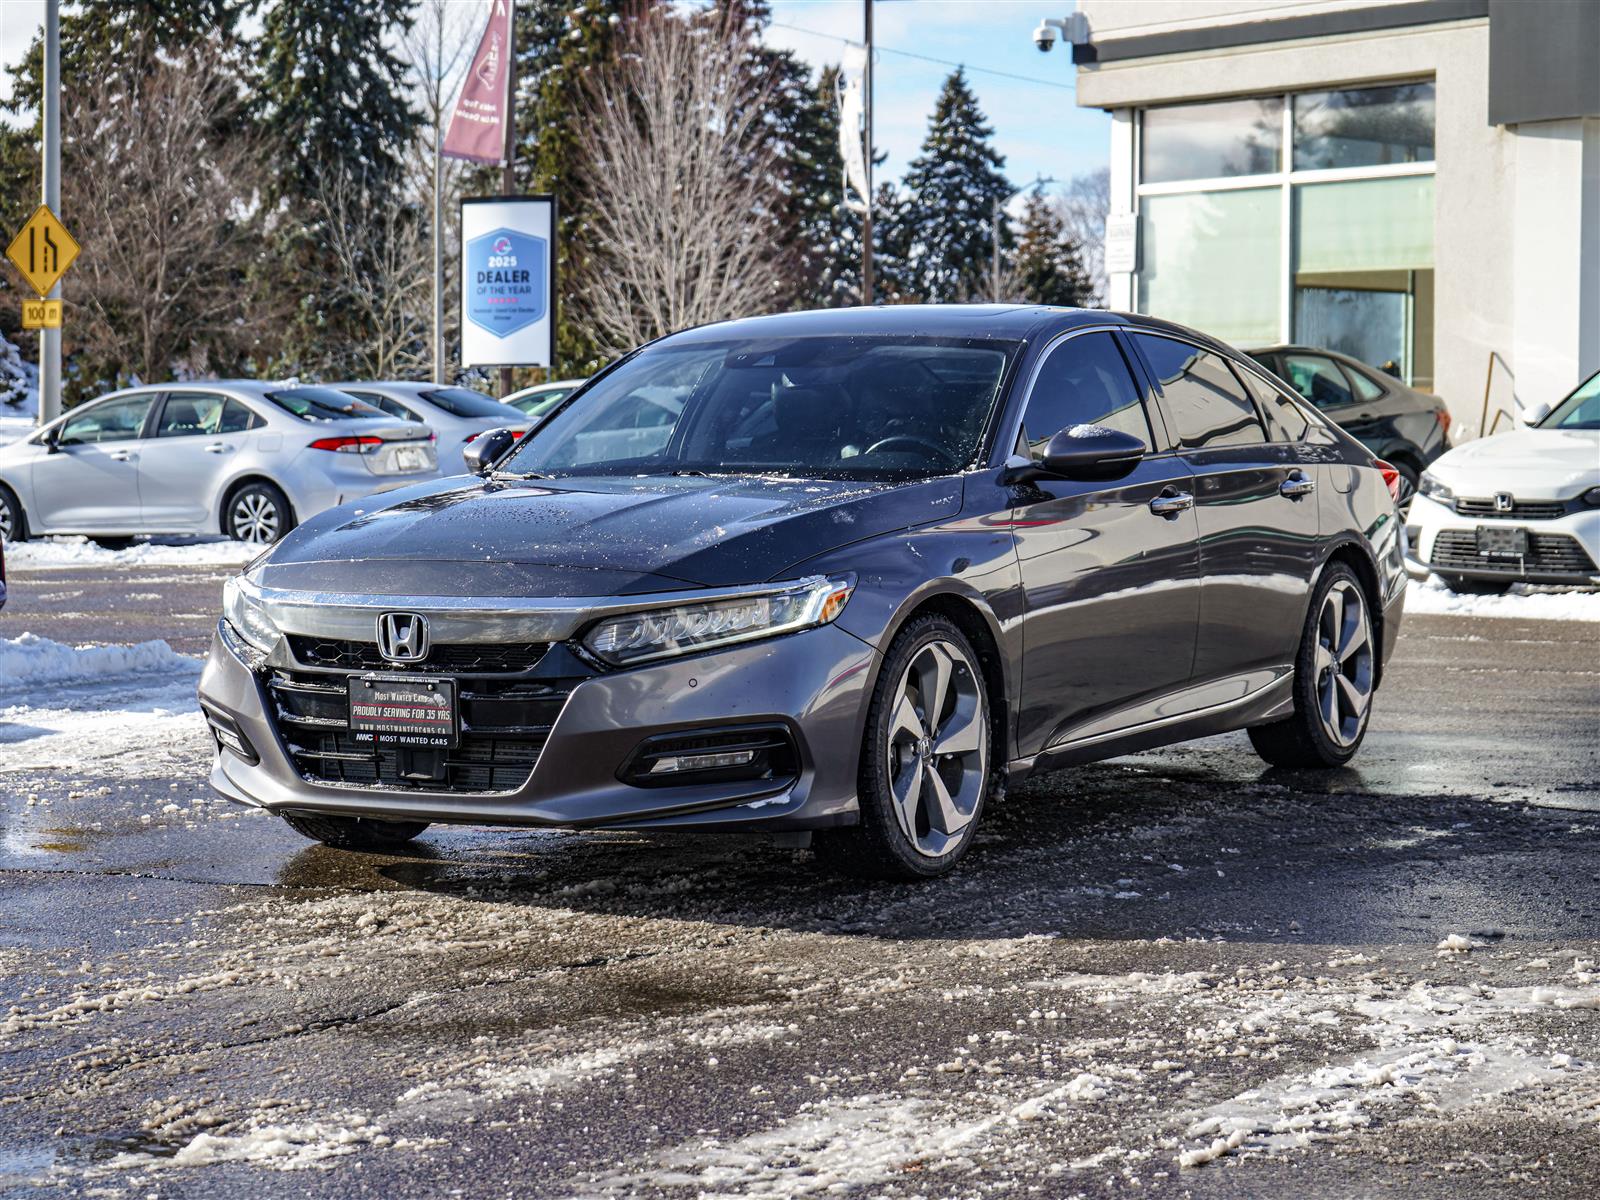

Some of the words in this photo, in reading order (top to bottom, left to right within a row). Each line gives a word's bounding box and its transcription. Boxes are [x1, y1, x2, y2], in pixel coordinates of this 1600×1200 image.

[488, 256, 517, 268] 2025
[477, 270, 530, 284] DEALER
[477, 286, 487, 295] OF
[490, 286, 505, 295] THE
[507, 285, 532, 295] YEAR
[27, 306, 45, 320] 100
[48, 309, 57, 319] m
[353, 705, 381, 717] PROUDLY
[383, 707, 410, 718] SERVING
[411, 708, 425, 719] FOR
[426, 709, 435, 720] 35
[437, 710, 452, 721] YRS.
[399, 736, 428, 744] WANTED
[430, 738, 448, 746] CARS
